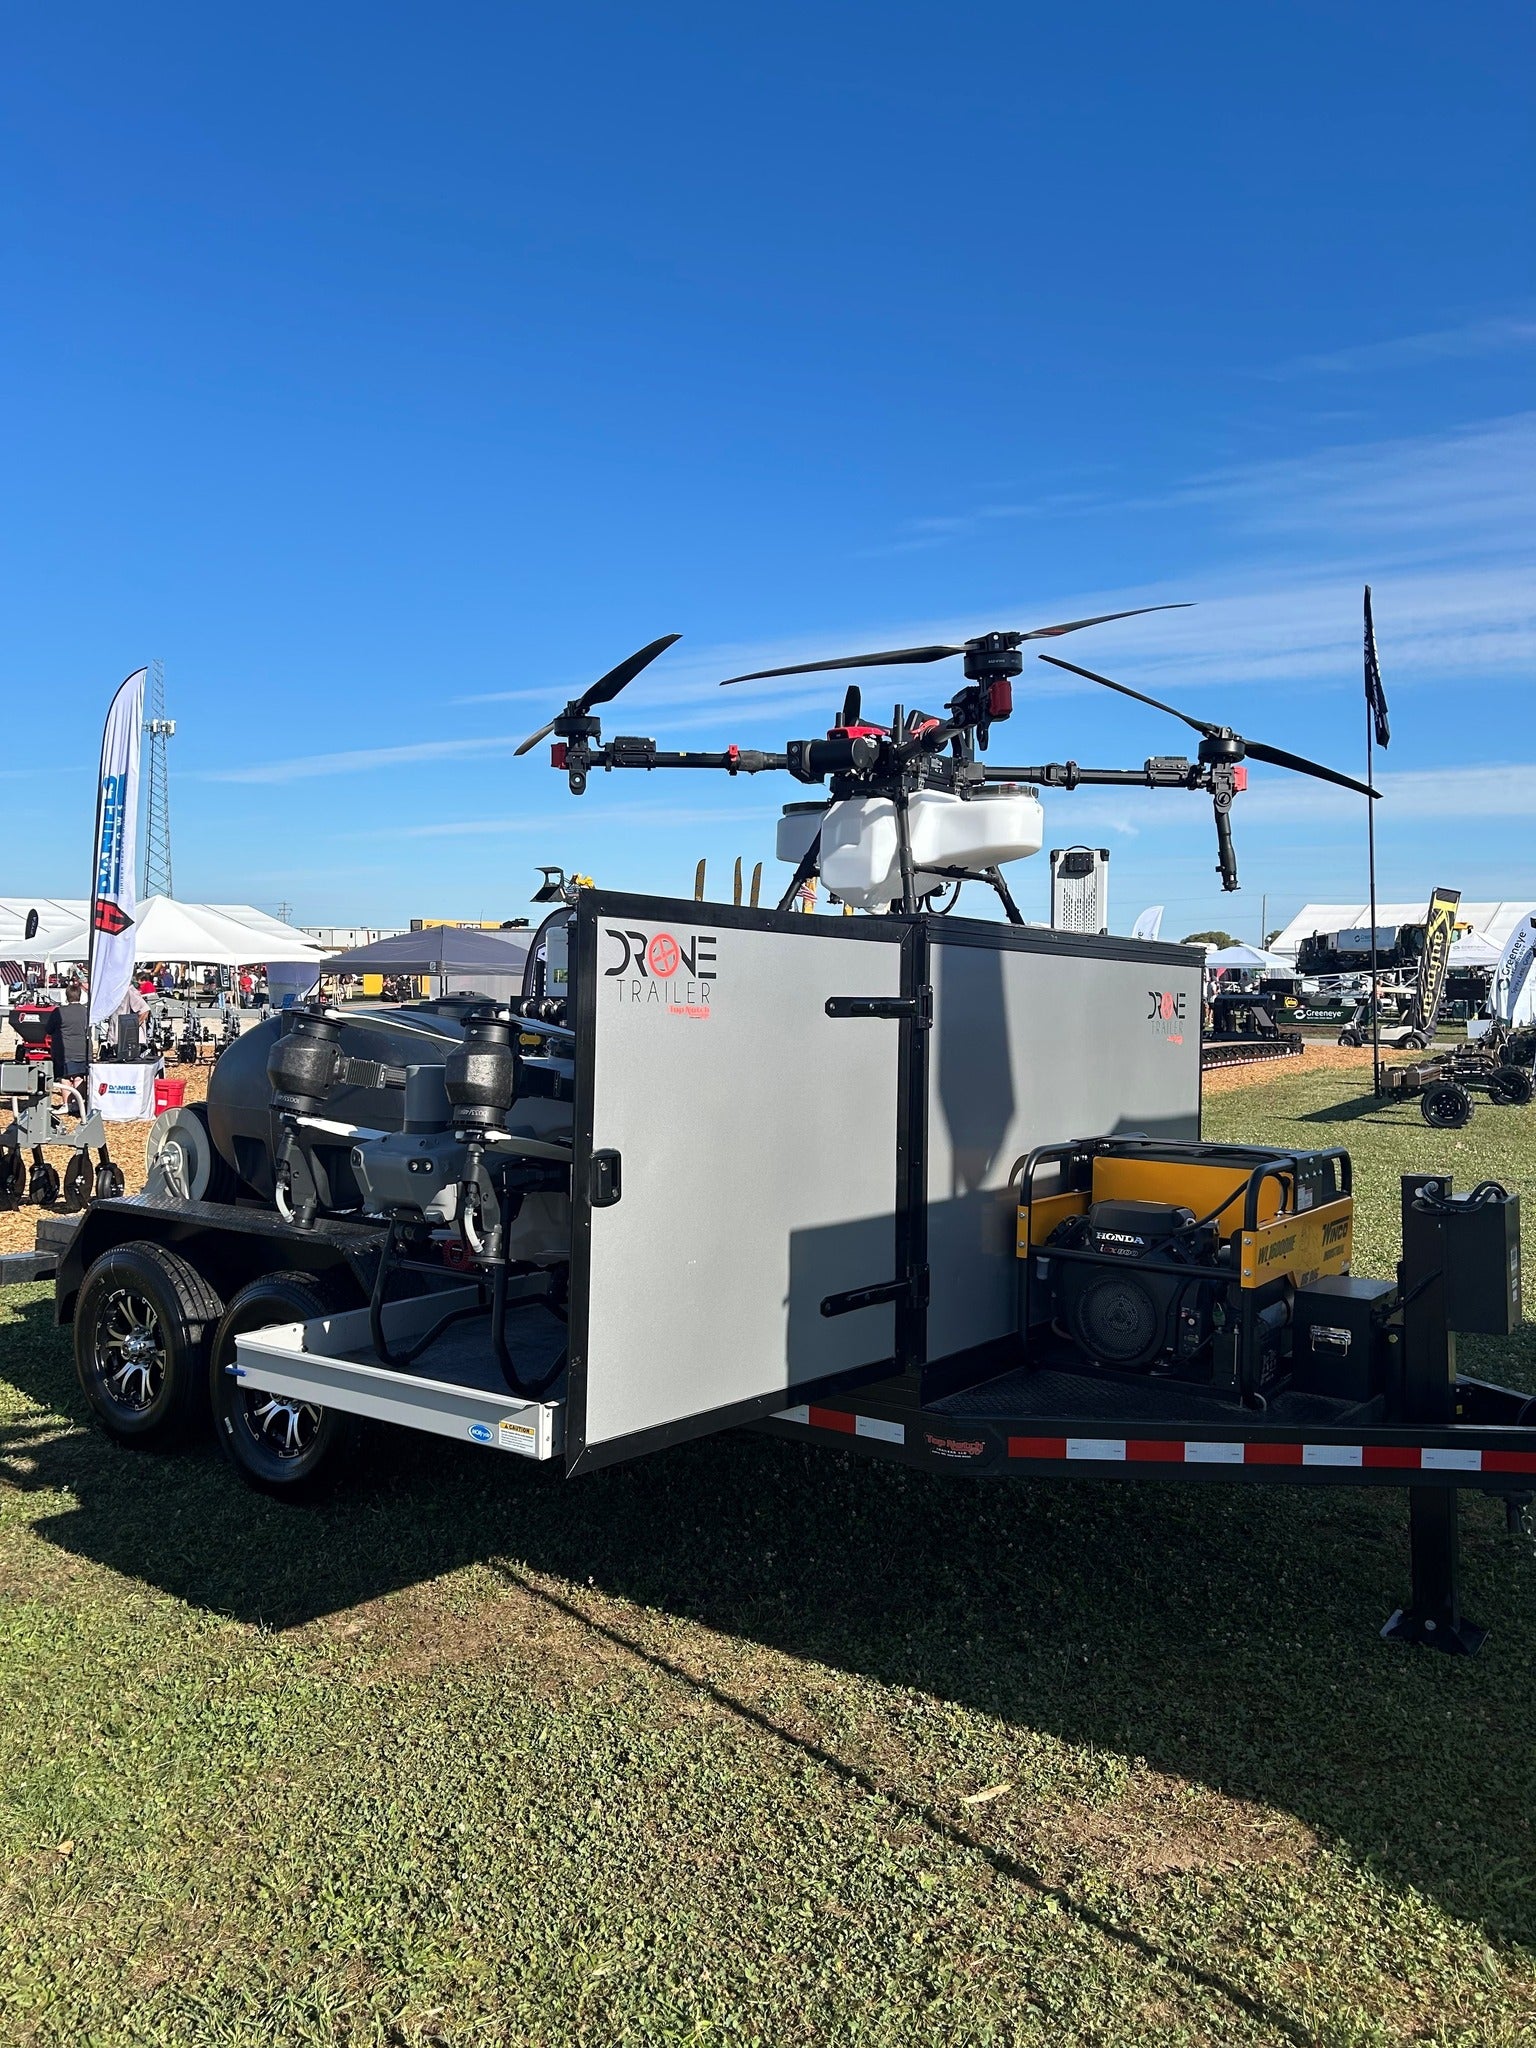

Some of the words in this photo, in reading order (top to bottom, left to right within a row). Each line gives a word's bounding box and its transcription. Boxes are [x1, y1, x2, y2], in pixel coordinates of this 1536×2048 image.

[98, 775, 117, 894] DANIELS
[604, 929, 717, 979] DRONE
[1423, 898, 1458, 1018] Kaufman
[616, 979, 711, 1004] TRAILER
[1147, 991, 1186, 1020] DRONE
[1306, 1009, 1342, 1018] Greeneye
[1096, 1231, 1145, 1245] HONDA
[508, 1424, 530, 1434] CAUTION
